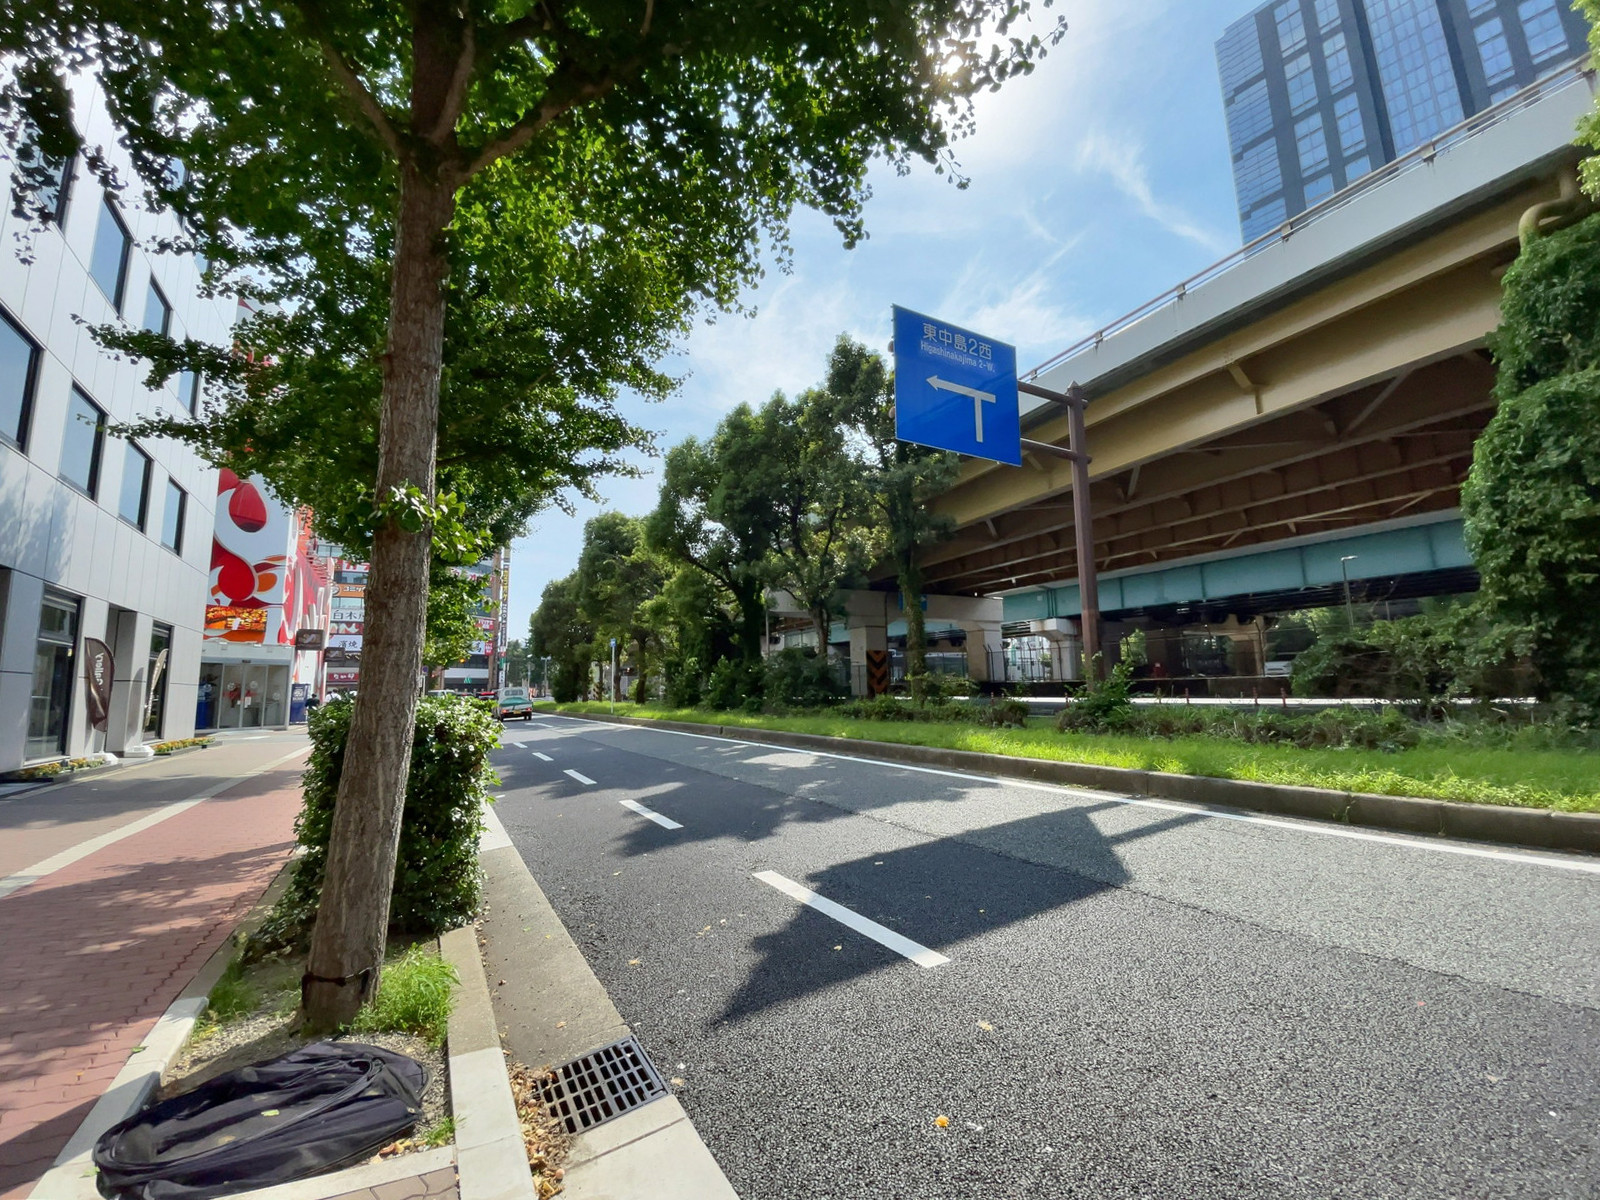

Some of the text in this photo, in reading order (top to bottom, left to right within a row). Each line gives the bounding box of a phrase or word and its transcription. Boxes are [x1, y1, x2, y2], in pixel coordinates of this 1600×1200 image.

[920, 340, 977, 367] Higashinakajima
[922, 322, 992, 360] 東中島2西
